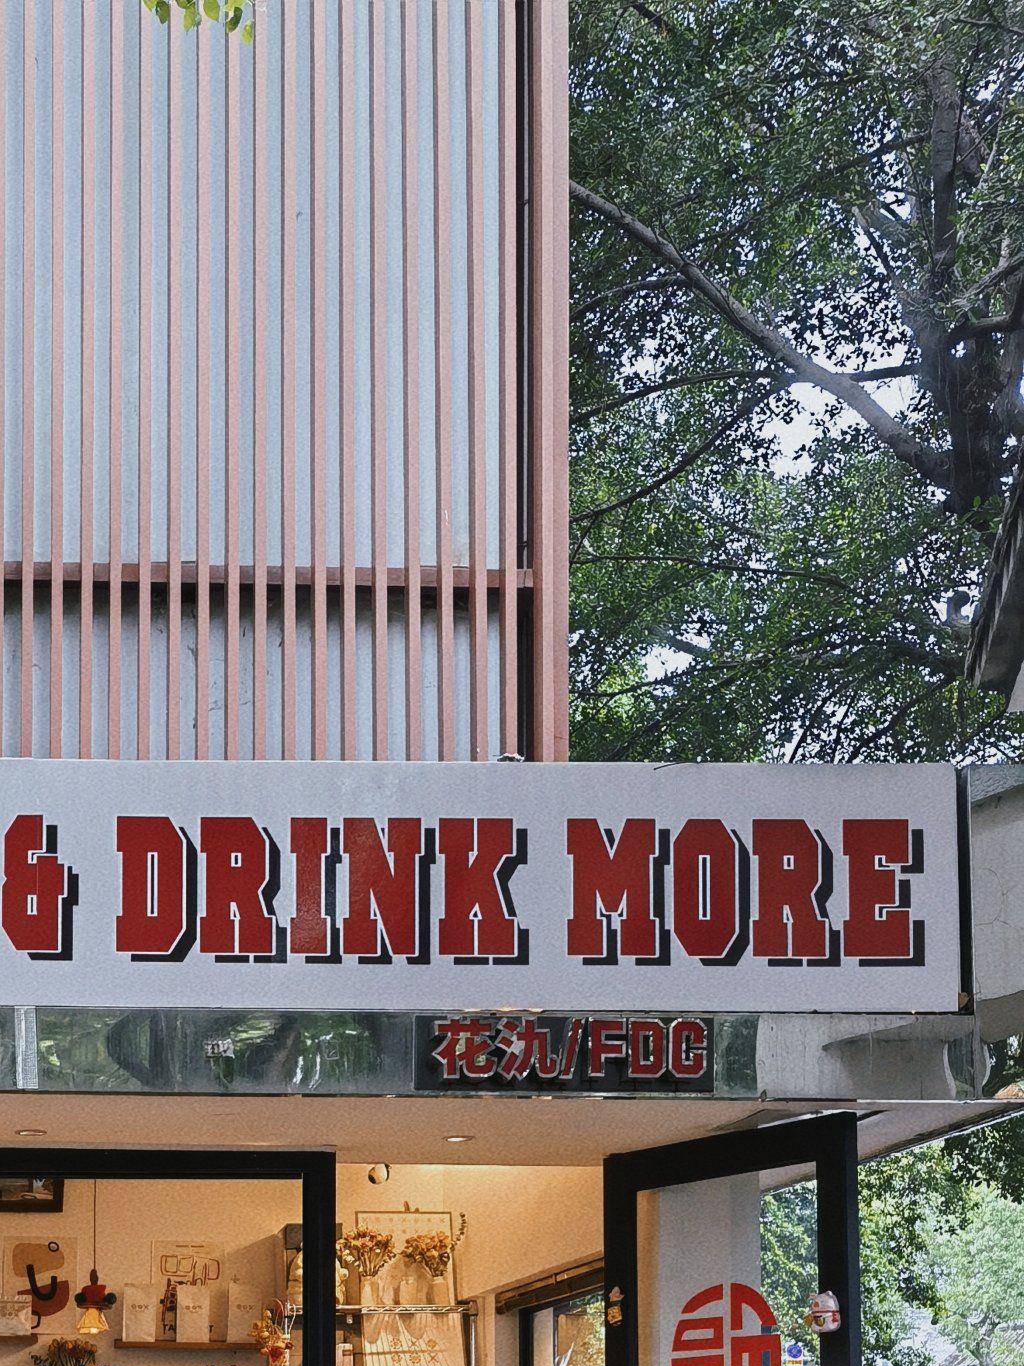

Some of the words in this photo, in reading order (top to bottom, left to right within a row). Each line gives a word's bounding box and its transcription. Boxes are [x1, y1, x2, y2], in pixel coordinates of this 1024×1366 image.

[2, 814, 79, 961] &
[115, 815, 530, 966] DRINK
[566, 817, 926, 968] MORE
